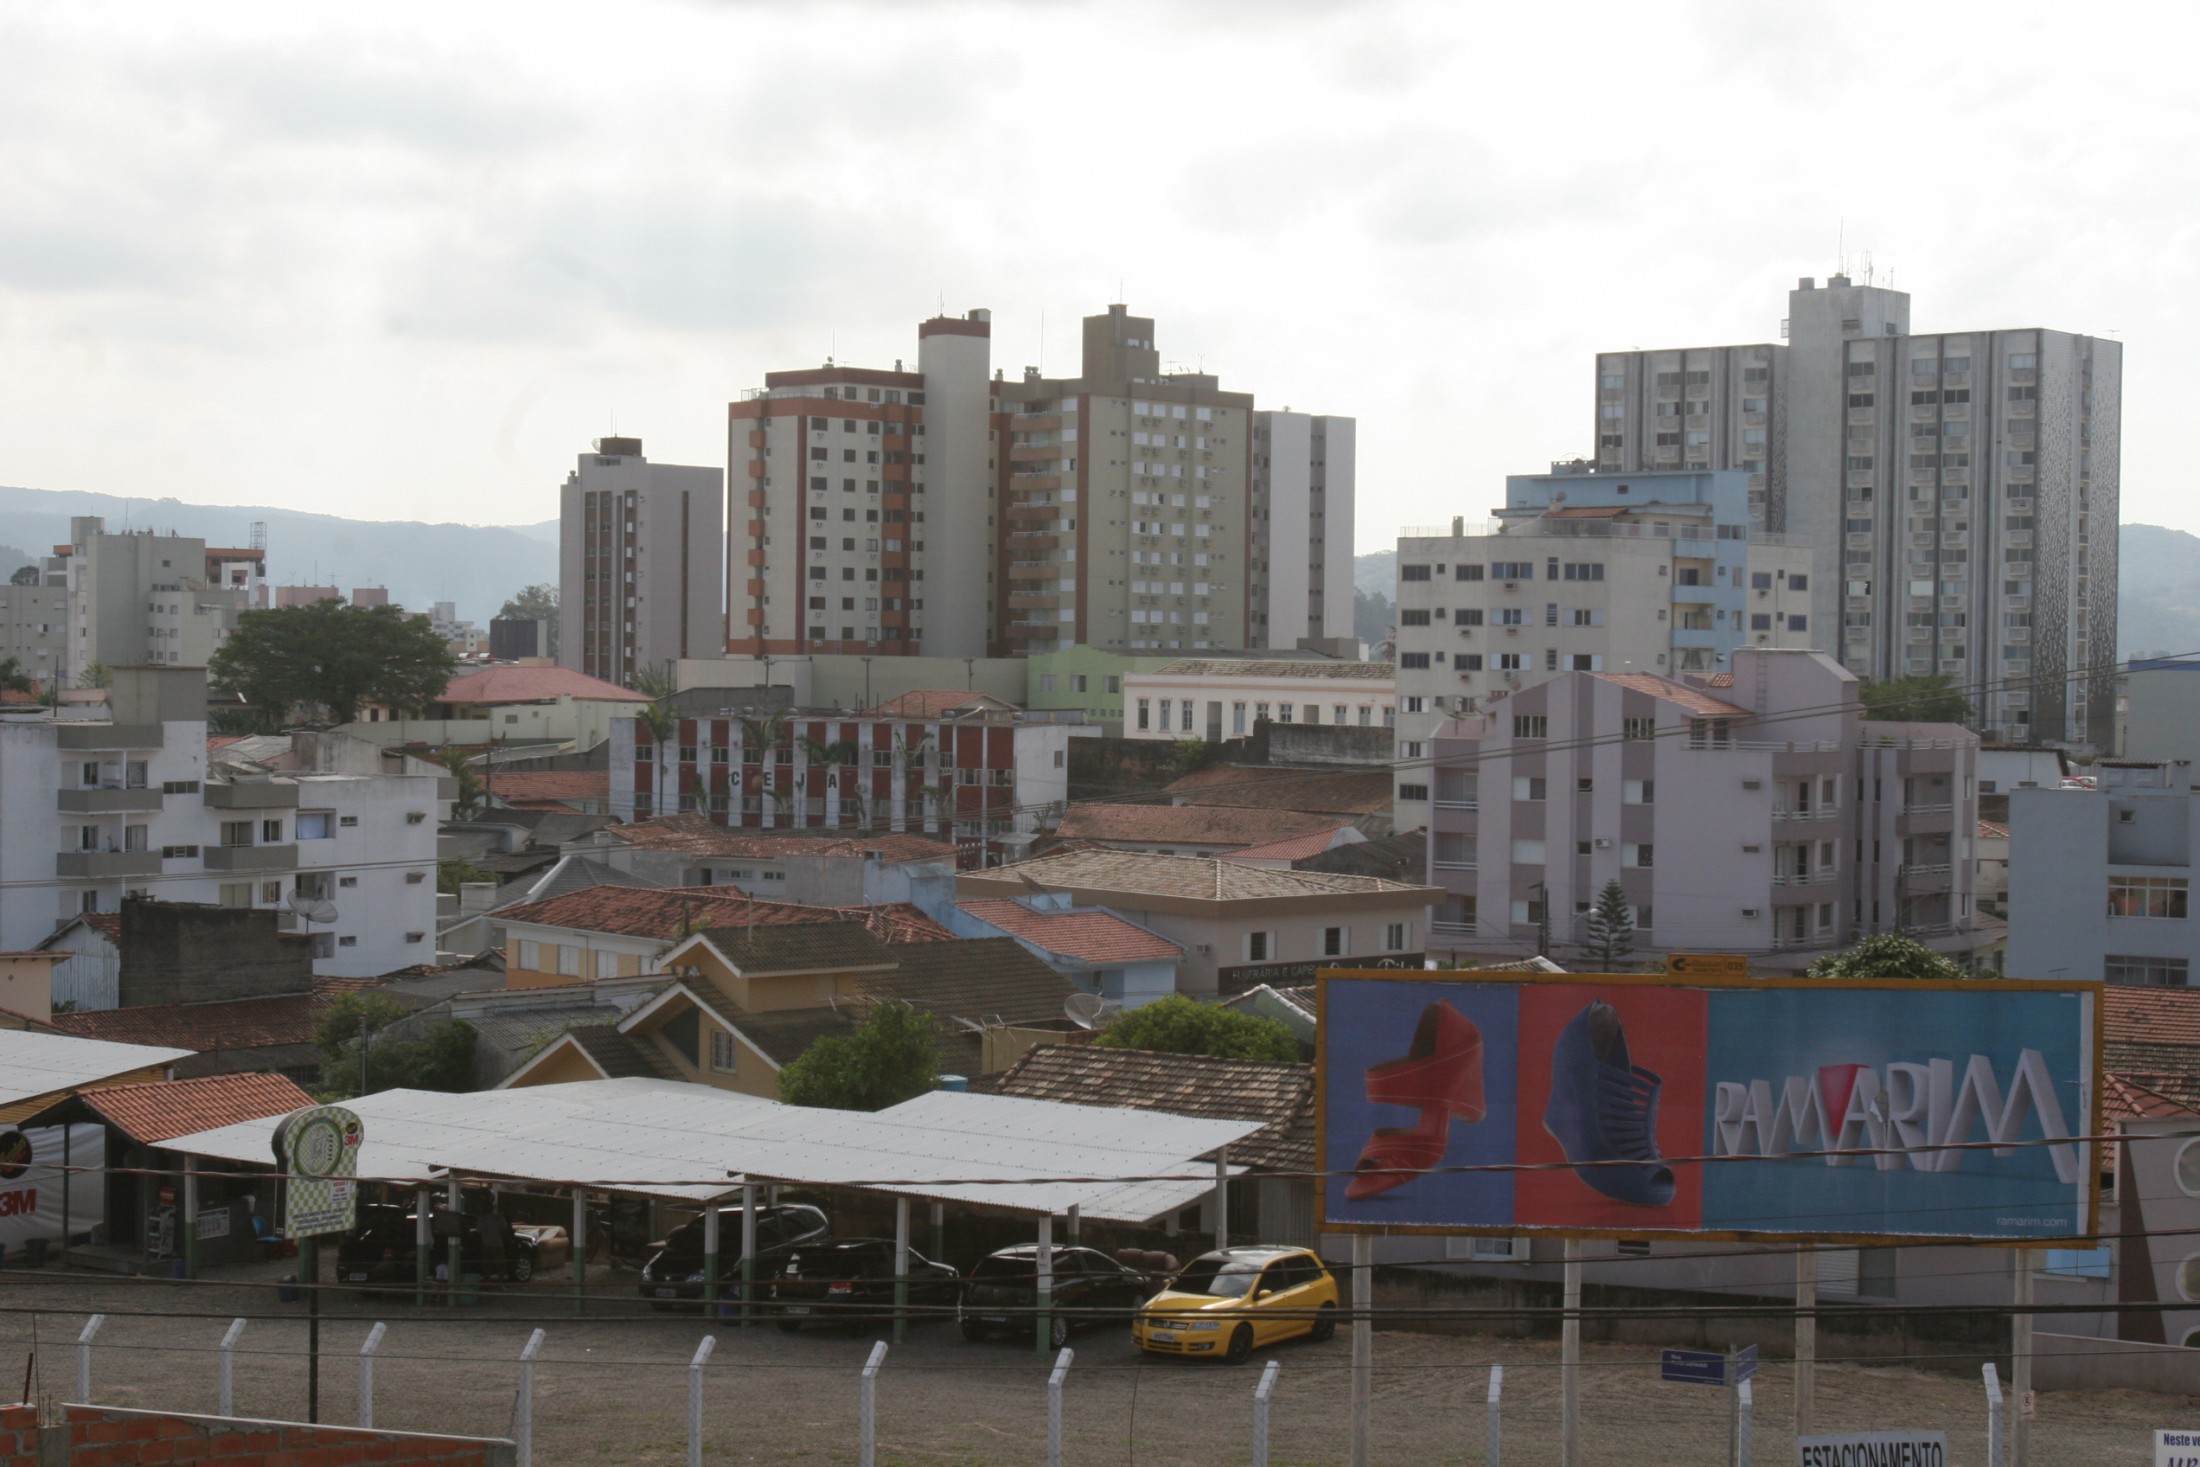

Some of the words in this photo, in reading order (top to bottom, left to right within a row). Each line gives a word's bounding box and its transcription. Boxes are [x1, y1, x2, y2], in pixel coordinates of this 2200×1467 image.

[1713, 1048, 2079, 1183] RAMARIM
[344, 1135, 358, 1147] 3M
[0, 1189, 37, 1217] 3M
[1996, 1216, 2067, 1227] ramarim.com
[2164, 1433, 2190, 1446] Neste
[1802, 1442, 1942, 1467] ESTACIONAMENTO
